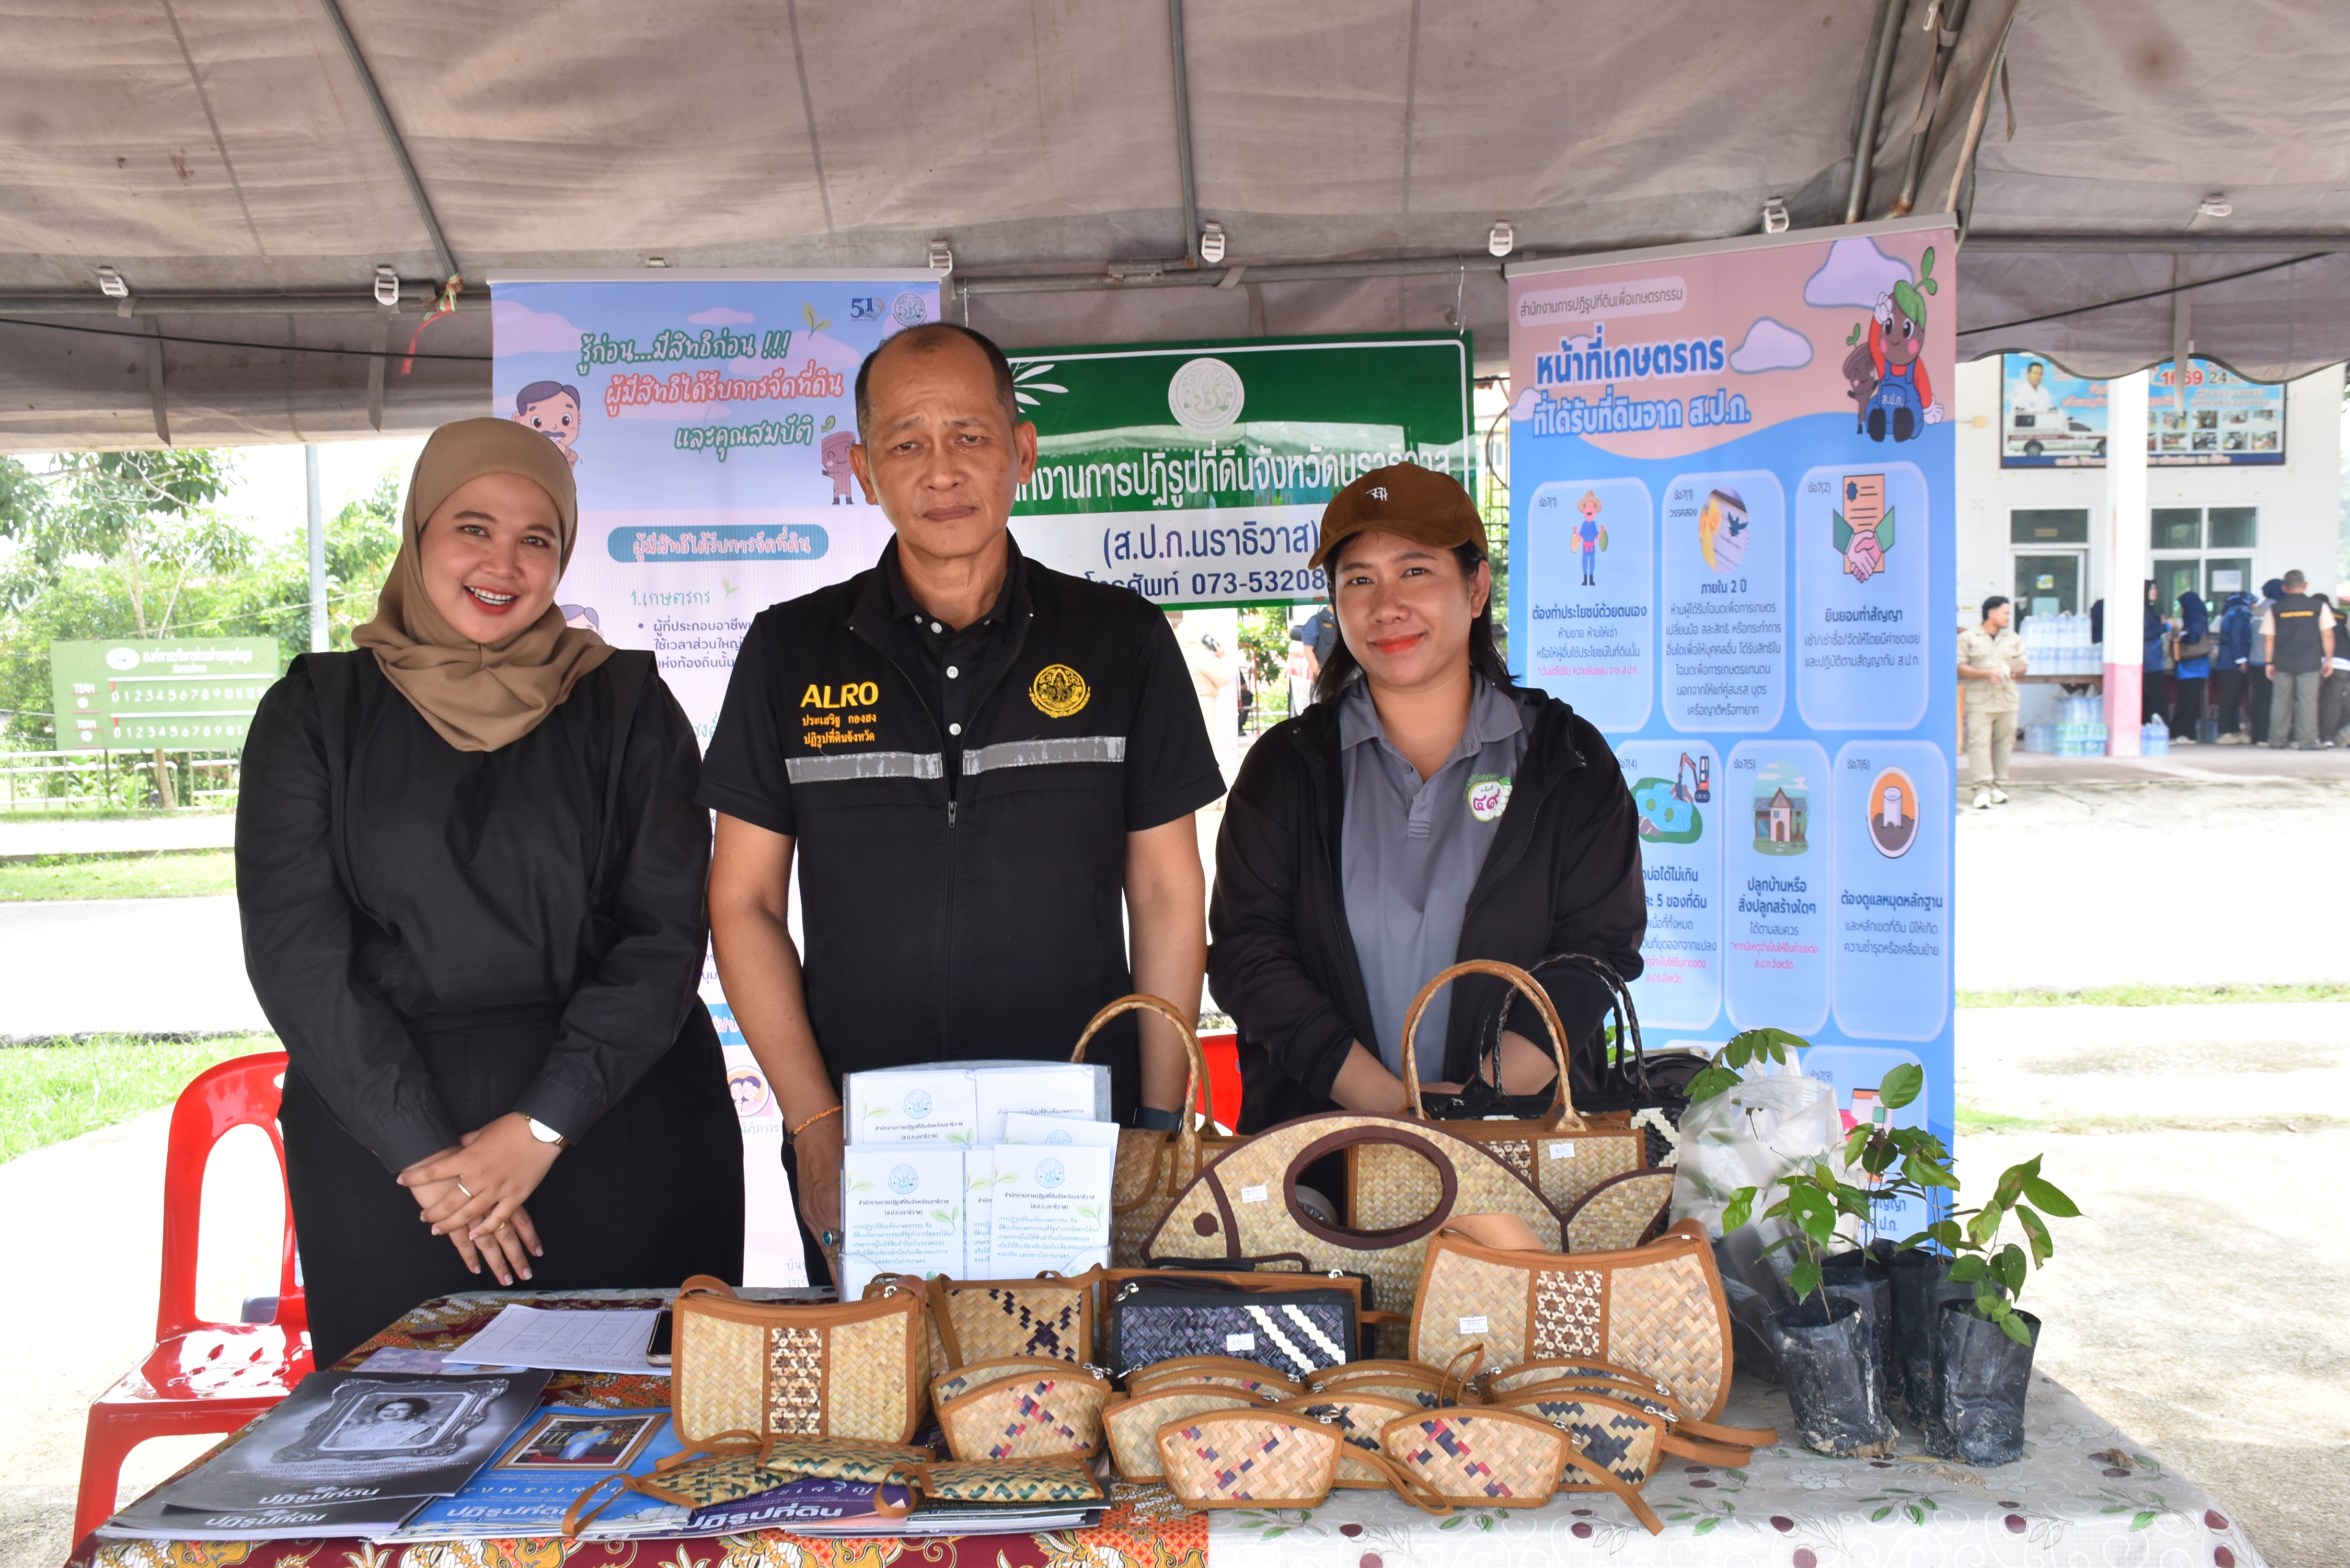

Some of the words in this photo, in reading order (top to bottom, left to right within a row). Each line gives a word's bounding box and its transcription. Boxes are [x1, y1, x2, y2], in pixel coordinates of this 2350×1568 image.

[1520, 287, 1683, 317] สำนักงานการปฏิรูปที่ดินเพื่อเกษตรกรรม
[577, 329, 756, 375] รู้ก่อน...มีสิทธิก่อน
[1536, 325, 1725, 384] หน้าที่เกษตรกร
[605, 360, 845, 417] ผู้มีสิทธิได้รับการจัดที่ดิน
[1882, 392, 1904, 406] ส.ป.ก.
[1534, 385, 1683, 438] ที่ได้รับที่ดินจาก
[1689, 388, 1752, 425] ส.ป.ก.
[675, 414, 813, 462] และคุณสมบัติ
[632, 528, 811, 562] ผู้มีสิทธิได้รับการจัดที่ดิน
[1103, 520, 1319, 569] (ส.ป.ก.นราธิวาส)
[1192, 568, 1326, 595] 073-53208
[1701, 581, 1727, 595] ภายใน
[1731, 580, 1737, 593] 2
[1740, 579, 1747, 593] ปี
[630, 590, 710, 607] 1.เกษตรกร
[1533, 604, 1646, 620] ต้องทำประโยชน์ด้วยตนเอง
[1825, 605, 1903, 623] ยินยอมทำสัญญา
[1558, 627, 1584, 639] ห้ามขาย
[654, 636, 745, 651] ใช้เวลาส่วนใหญ่
[73, 684, 95, 694] TEAM
[134, 690, 142, 702] 2
[146, 690, 153, 702] 3
[157, 690, 164, 701] 4
[168, 689, 177, 701] 5
[180, 690, 188, 701] 6
[191, 689, 198, 700] 7
[201, 688, 210, 700] 8
[800, 681, 879, 708] ALRO
[76, 720, 97, 729] TEAM
[136, 726, 143, 739] 2
[148, 726, 156, 738] 3
[158, 726, 166, 737] 4
[170, 725, 178, 737] 5
[181, 727, 189, 737] 6
[193, 725, 200, 736] 7
[203, 725, 211, 737] 8
[802, 712, 840, 728] ประเสริฐ
[803, 728, 875, 748] ปฏิรูปที่ดินจังหวัด
[1619, 758, 1637, 770] อ7(4)
[1748, 875, 1806, 897] ปลูกบ้านหรือ
[1657, 894, 1663, 907] 5
[1666, 889, 1707, 908] ของที่ดิน
[1738, 894, 1816, 918] สิ่งปลูกสร้างใดๆ
[1841, 890, 1943, 912] ต้องดูแลหมุดหลักฐาน
[1647, 914, 1693, 930] เนื้อที่ทั้งหมด
[1750, 921, 1799, 936] ได้ตามสมควร
[259, 1487, 381, 1506] ปฏิรูปที่ดิน
[205, 1510, 328, 1528] ปฏิรูปที่ดิน
